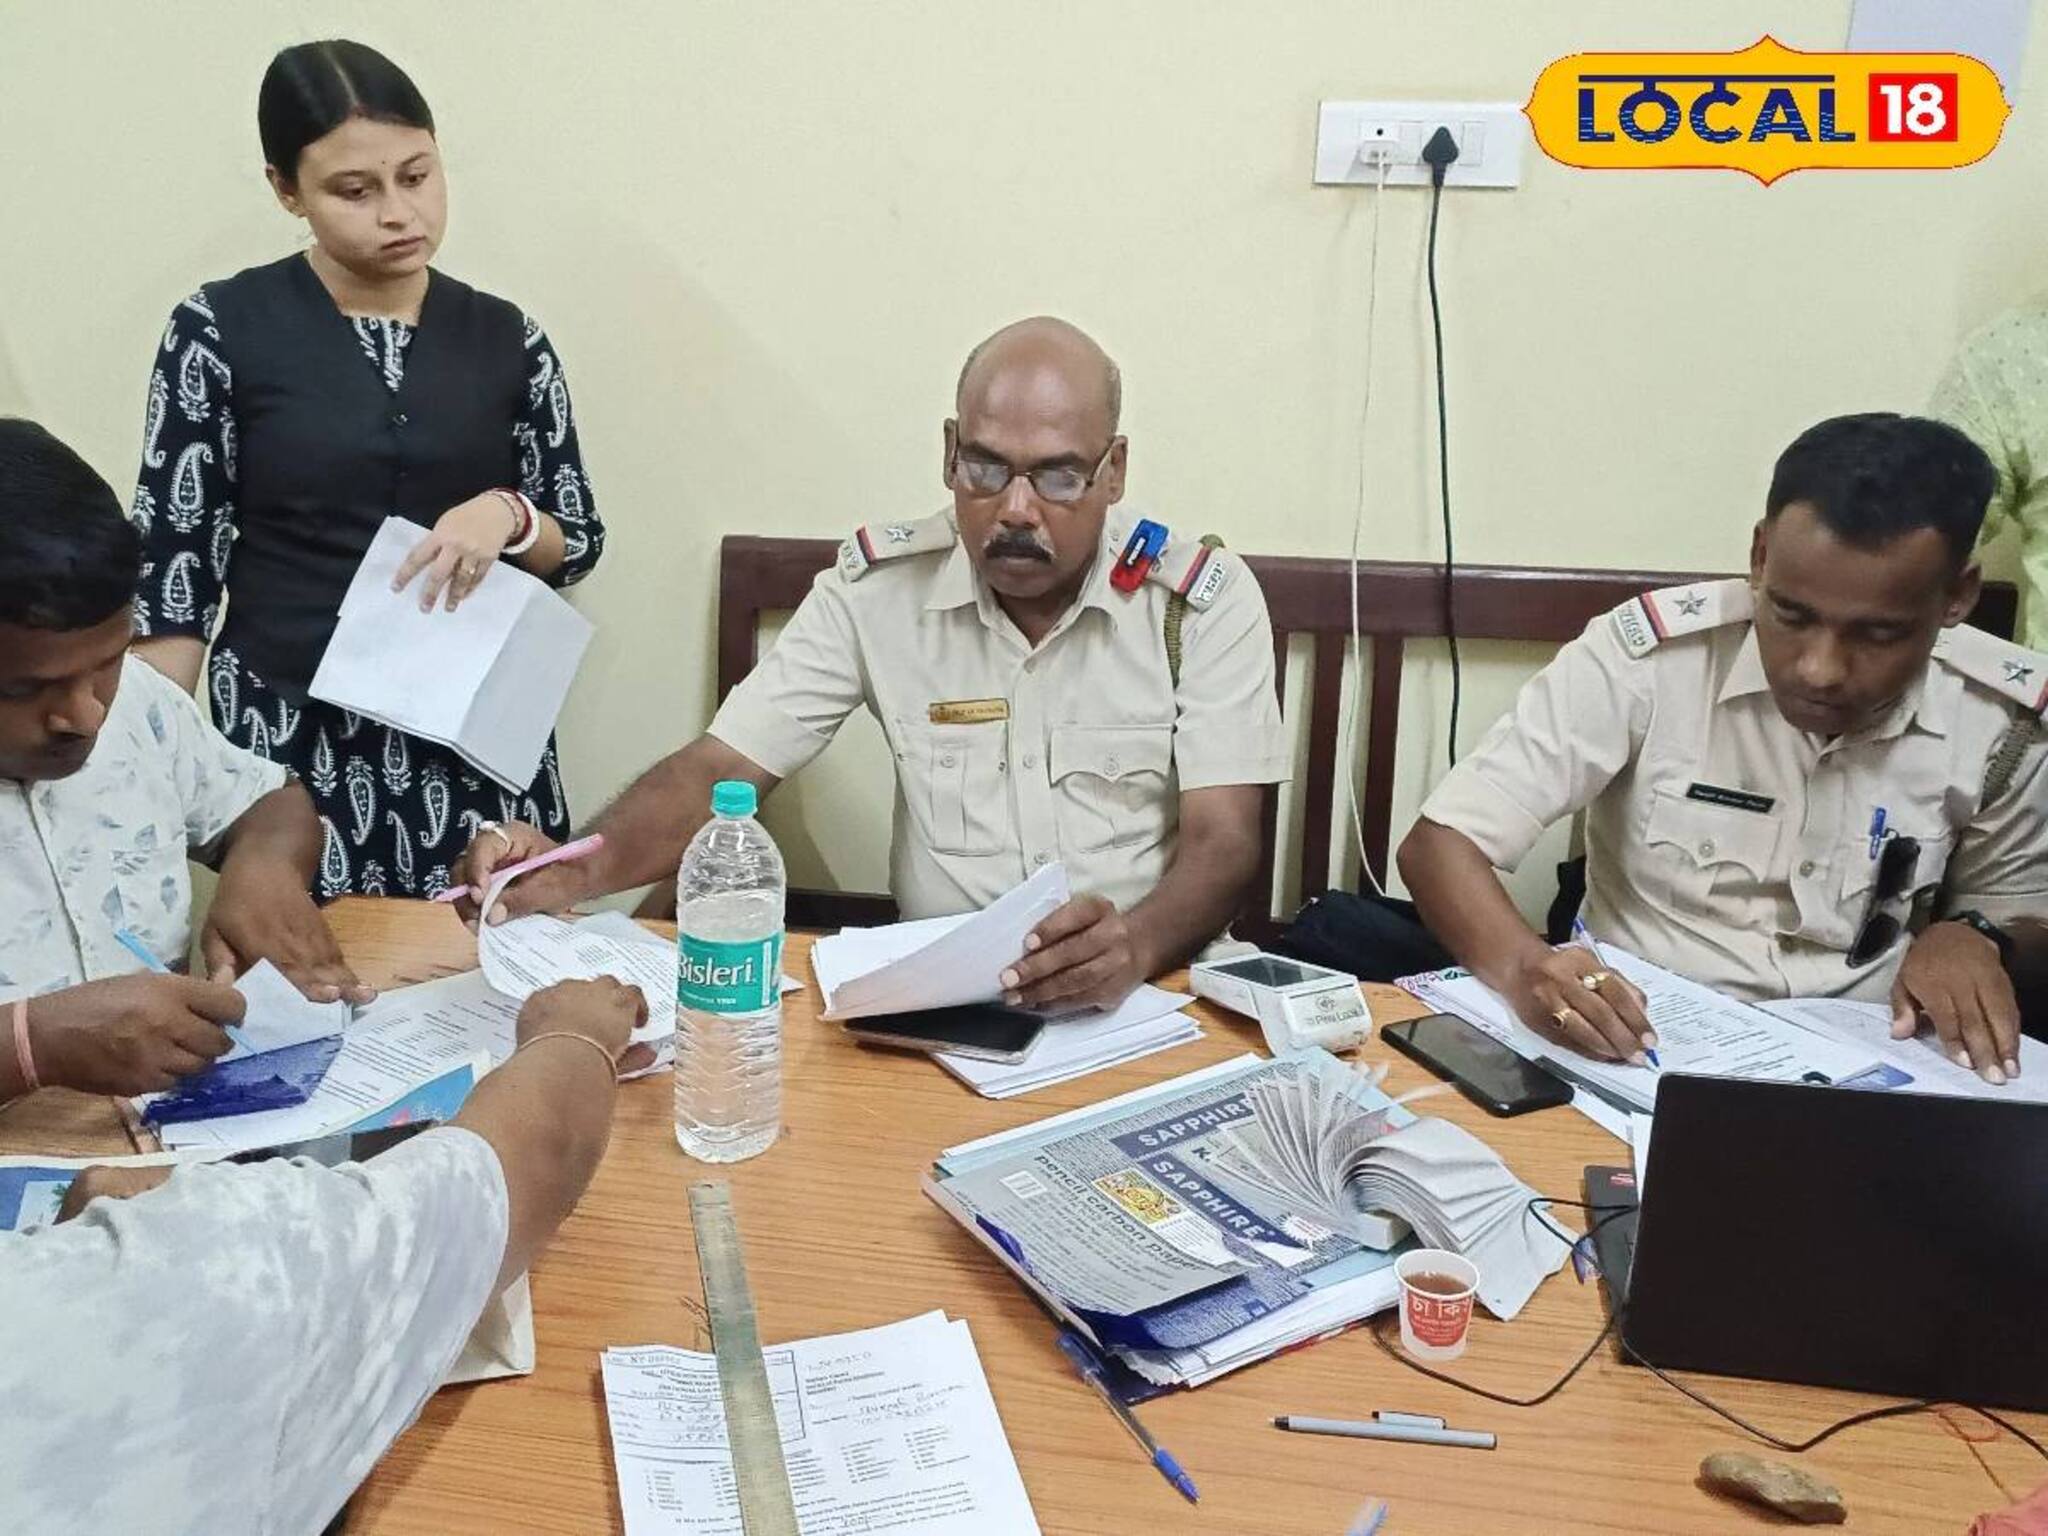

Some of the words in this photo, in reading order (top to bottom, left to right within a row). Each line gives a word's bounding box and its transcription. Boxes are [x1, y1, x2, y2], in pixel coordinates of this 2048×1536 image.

[677, 951, 754, 986] Bisleri
[1034, 1155, 1087, 1194] pencil
[1087, 1194, 1146, 1240] carbon
[1145, 1243, 1204, 1270] paper
[1152, 1161, 1265, 1238] SAPPHIRE
